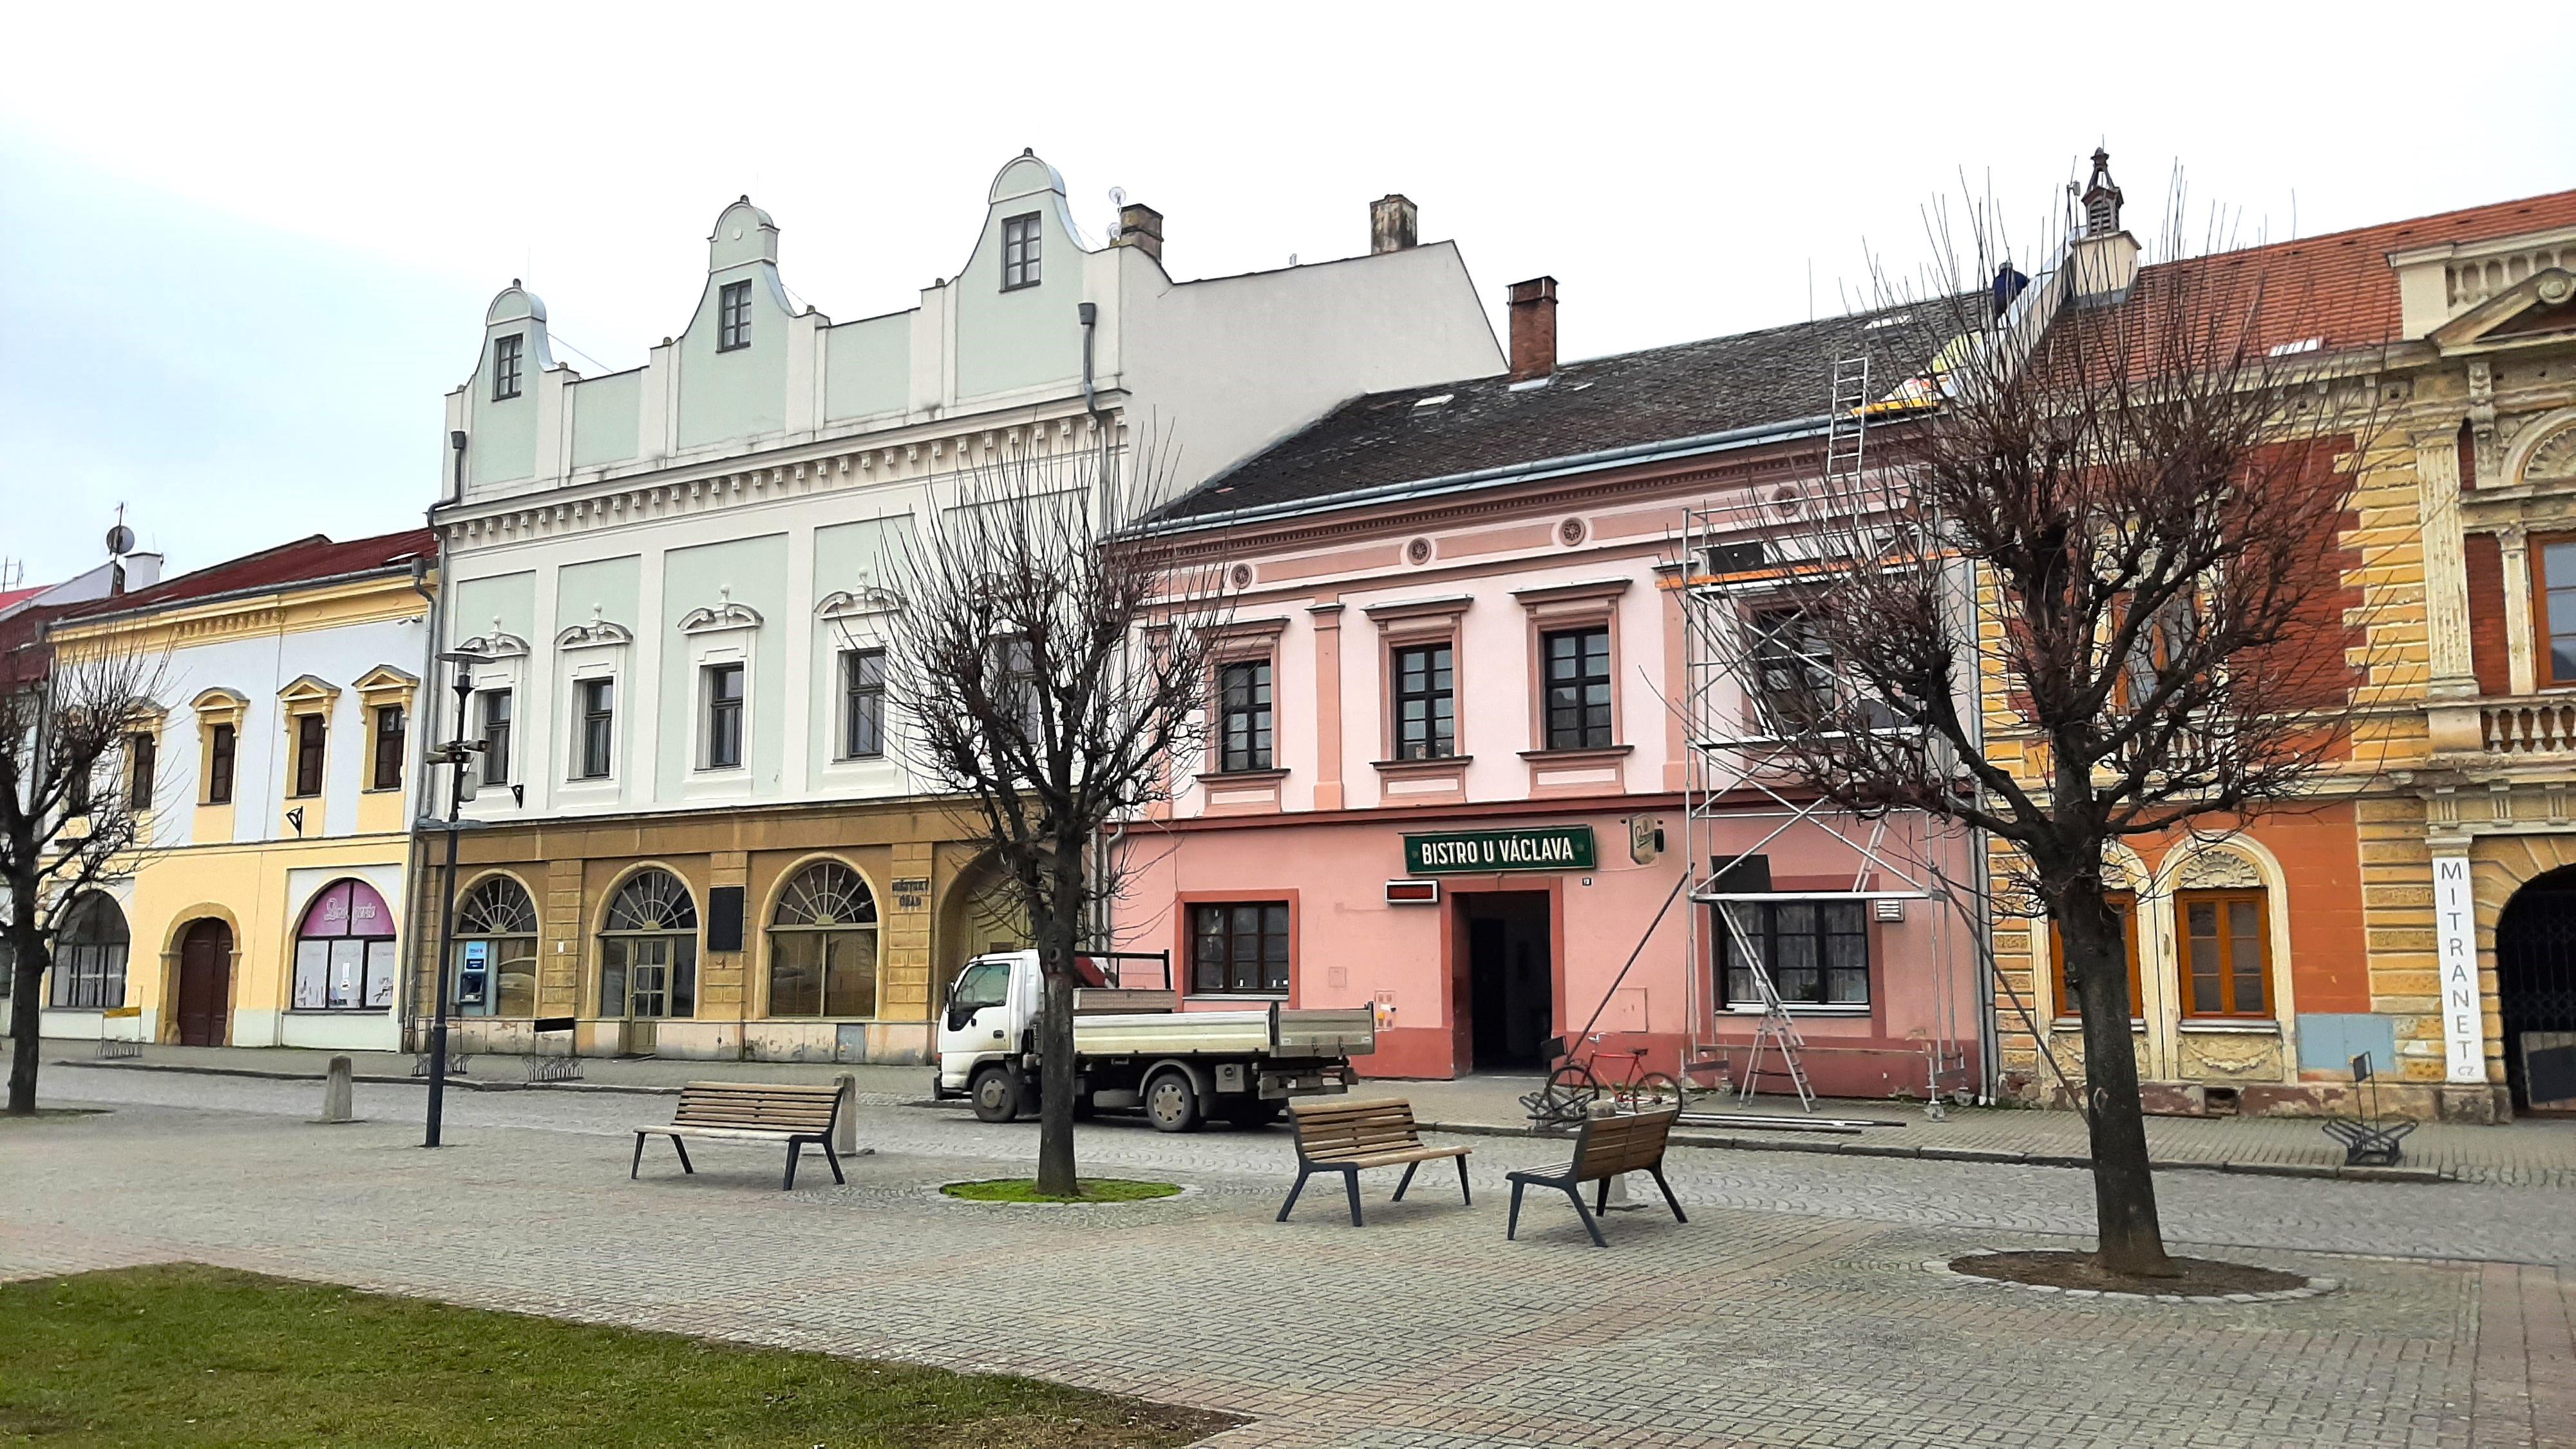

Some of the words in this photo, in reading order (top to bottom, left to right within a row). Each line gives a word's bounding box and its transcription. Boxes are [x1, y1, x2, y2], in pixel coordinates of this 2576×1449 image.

[1422, 841, 1477, 865] BISTRO
[1483, 840, 1494, 862] U
[1499, 835, 1574, 862] VÁCLAVA
[2441, 862, 2472, 1061] MITRANET
